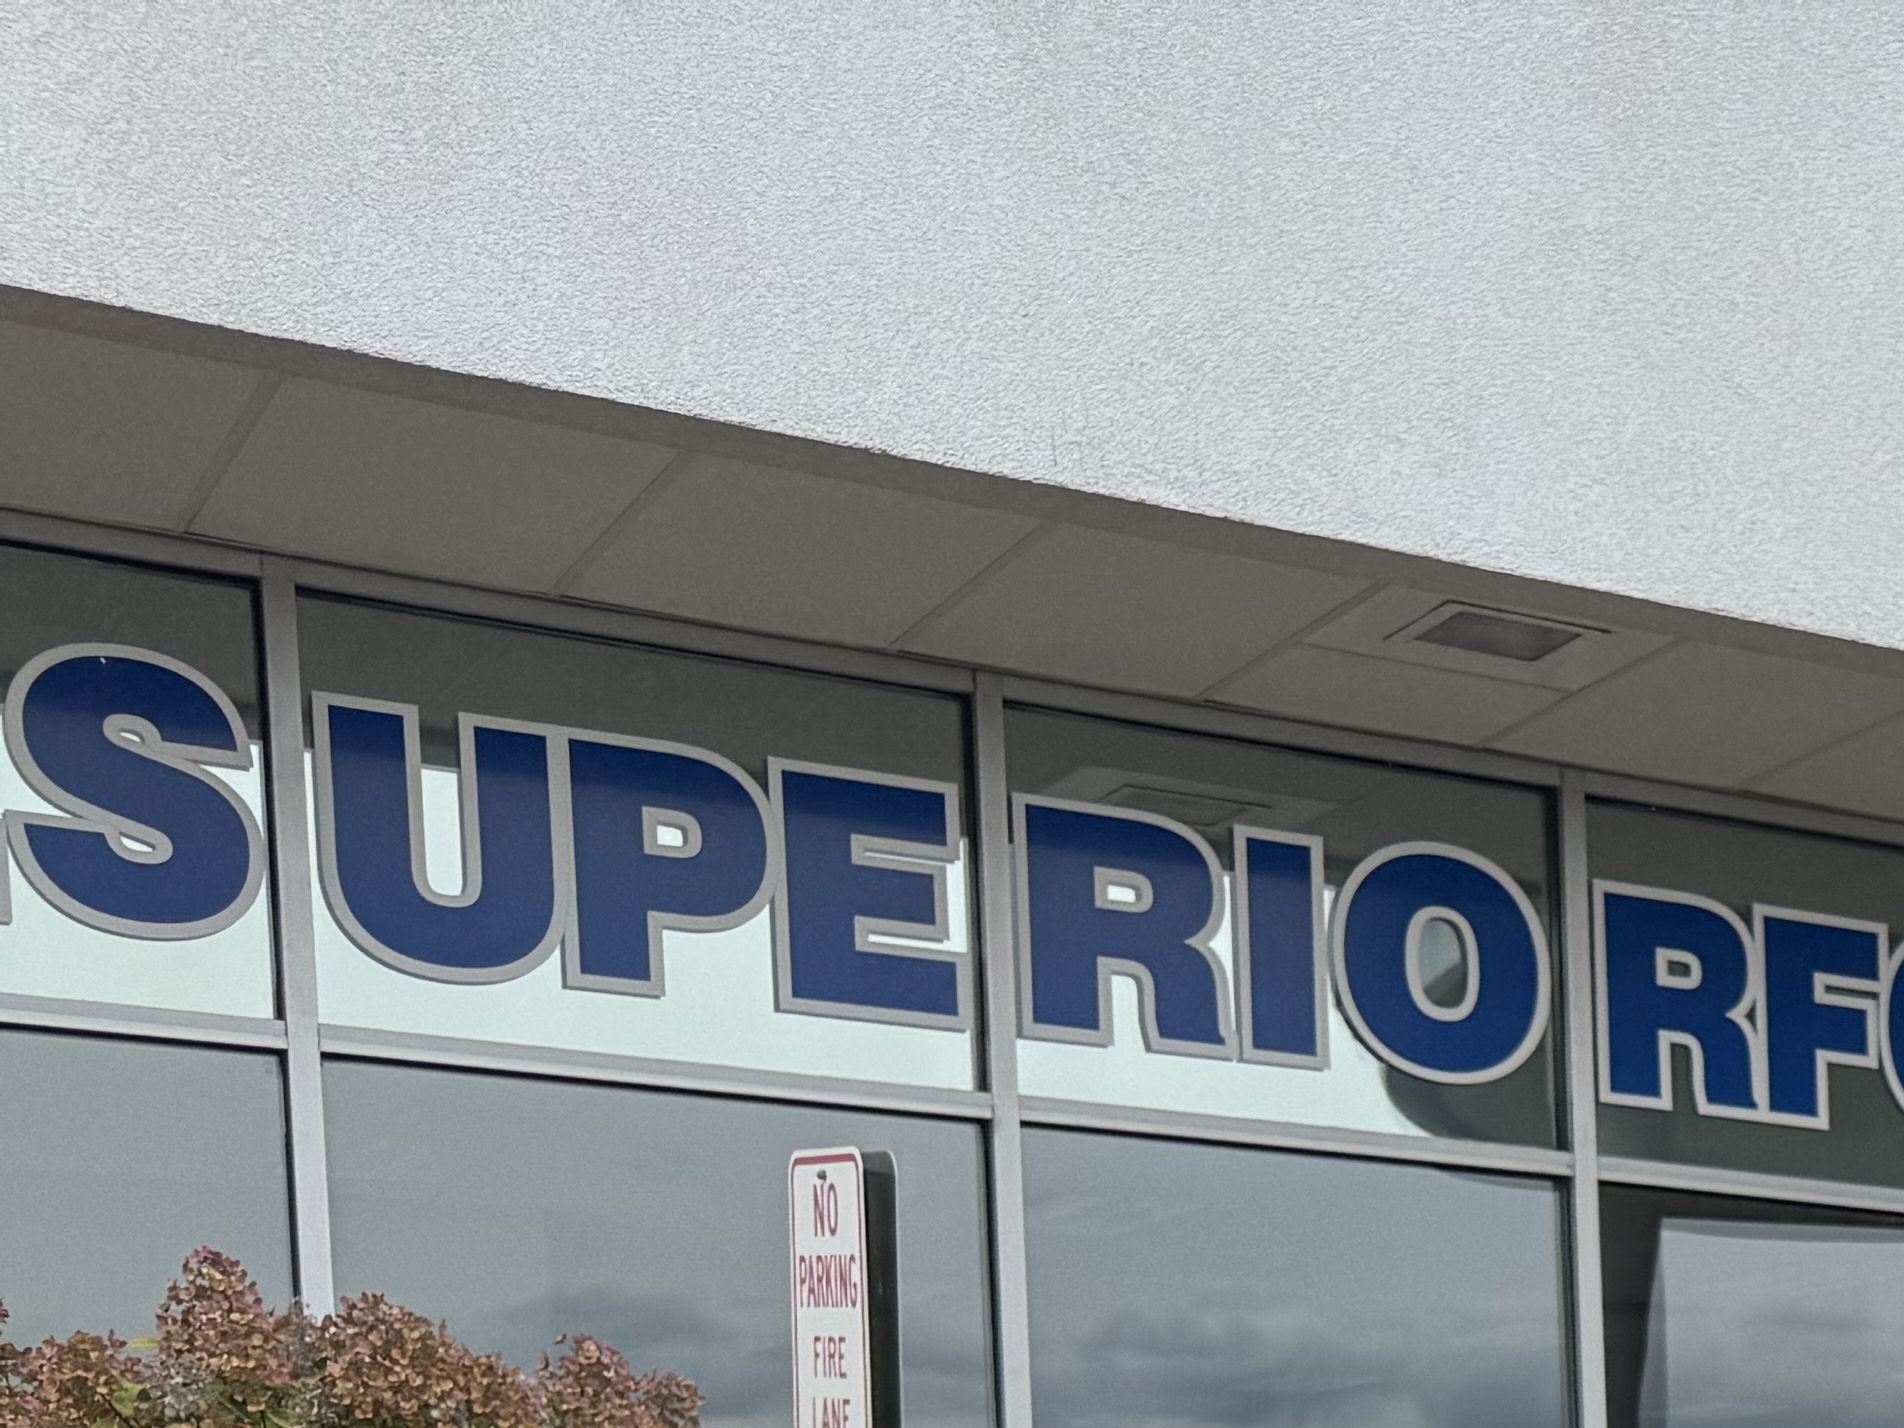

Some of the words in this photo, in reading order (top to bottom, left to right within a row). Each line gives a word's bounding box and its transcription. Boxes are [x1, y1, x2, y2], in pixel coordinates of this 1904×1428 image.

[813, 1182, 839, 1237] NO
[799, 1254, 858, 1309] PARKING
[814, 1336, 847, 1379] FIRE
